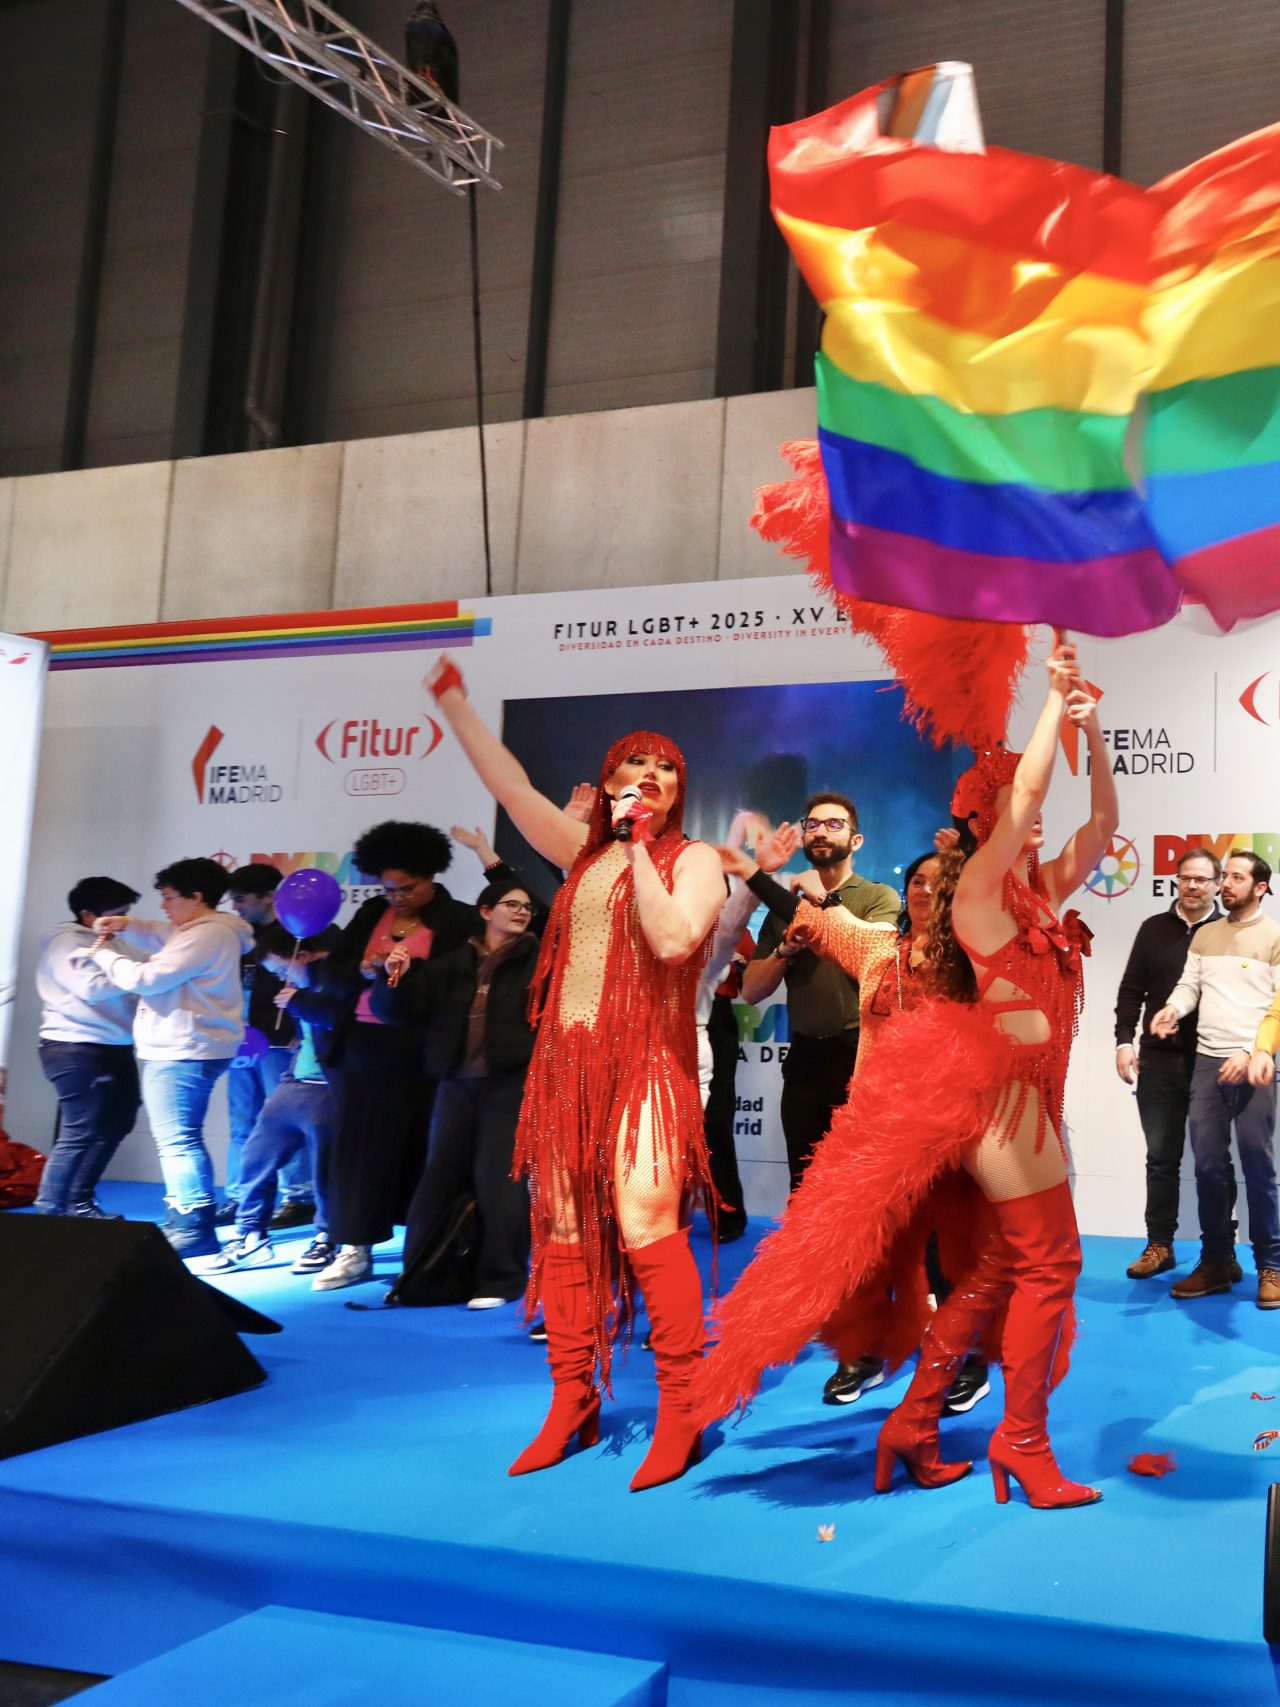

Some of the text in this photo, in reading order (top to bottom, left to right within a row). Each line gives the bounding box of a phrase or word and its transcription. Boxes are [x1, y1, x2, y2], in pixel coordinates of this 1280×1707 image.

[554, 620, 617, 639] FITUR
[629, 616, 699, 635] LGBT+
[711, 611, 764, 630] 2025
[792, 607, 824, 625] XV
[559, 626, 847, 651] DIVERSIDAD EN CADA DESTINO DIVERSITY IN EVERY
[340, 719, 421, 759] Fitur
[1102, 728, 1171, 750] FEMA
[210, 765, 268, 783] IFEMA
[1087, 752, 1194, 776] ADRID
[352, 773, 398, 791] LGBT+
[208, 785, 283, 804] MADRID
